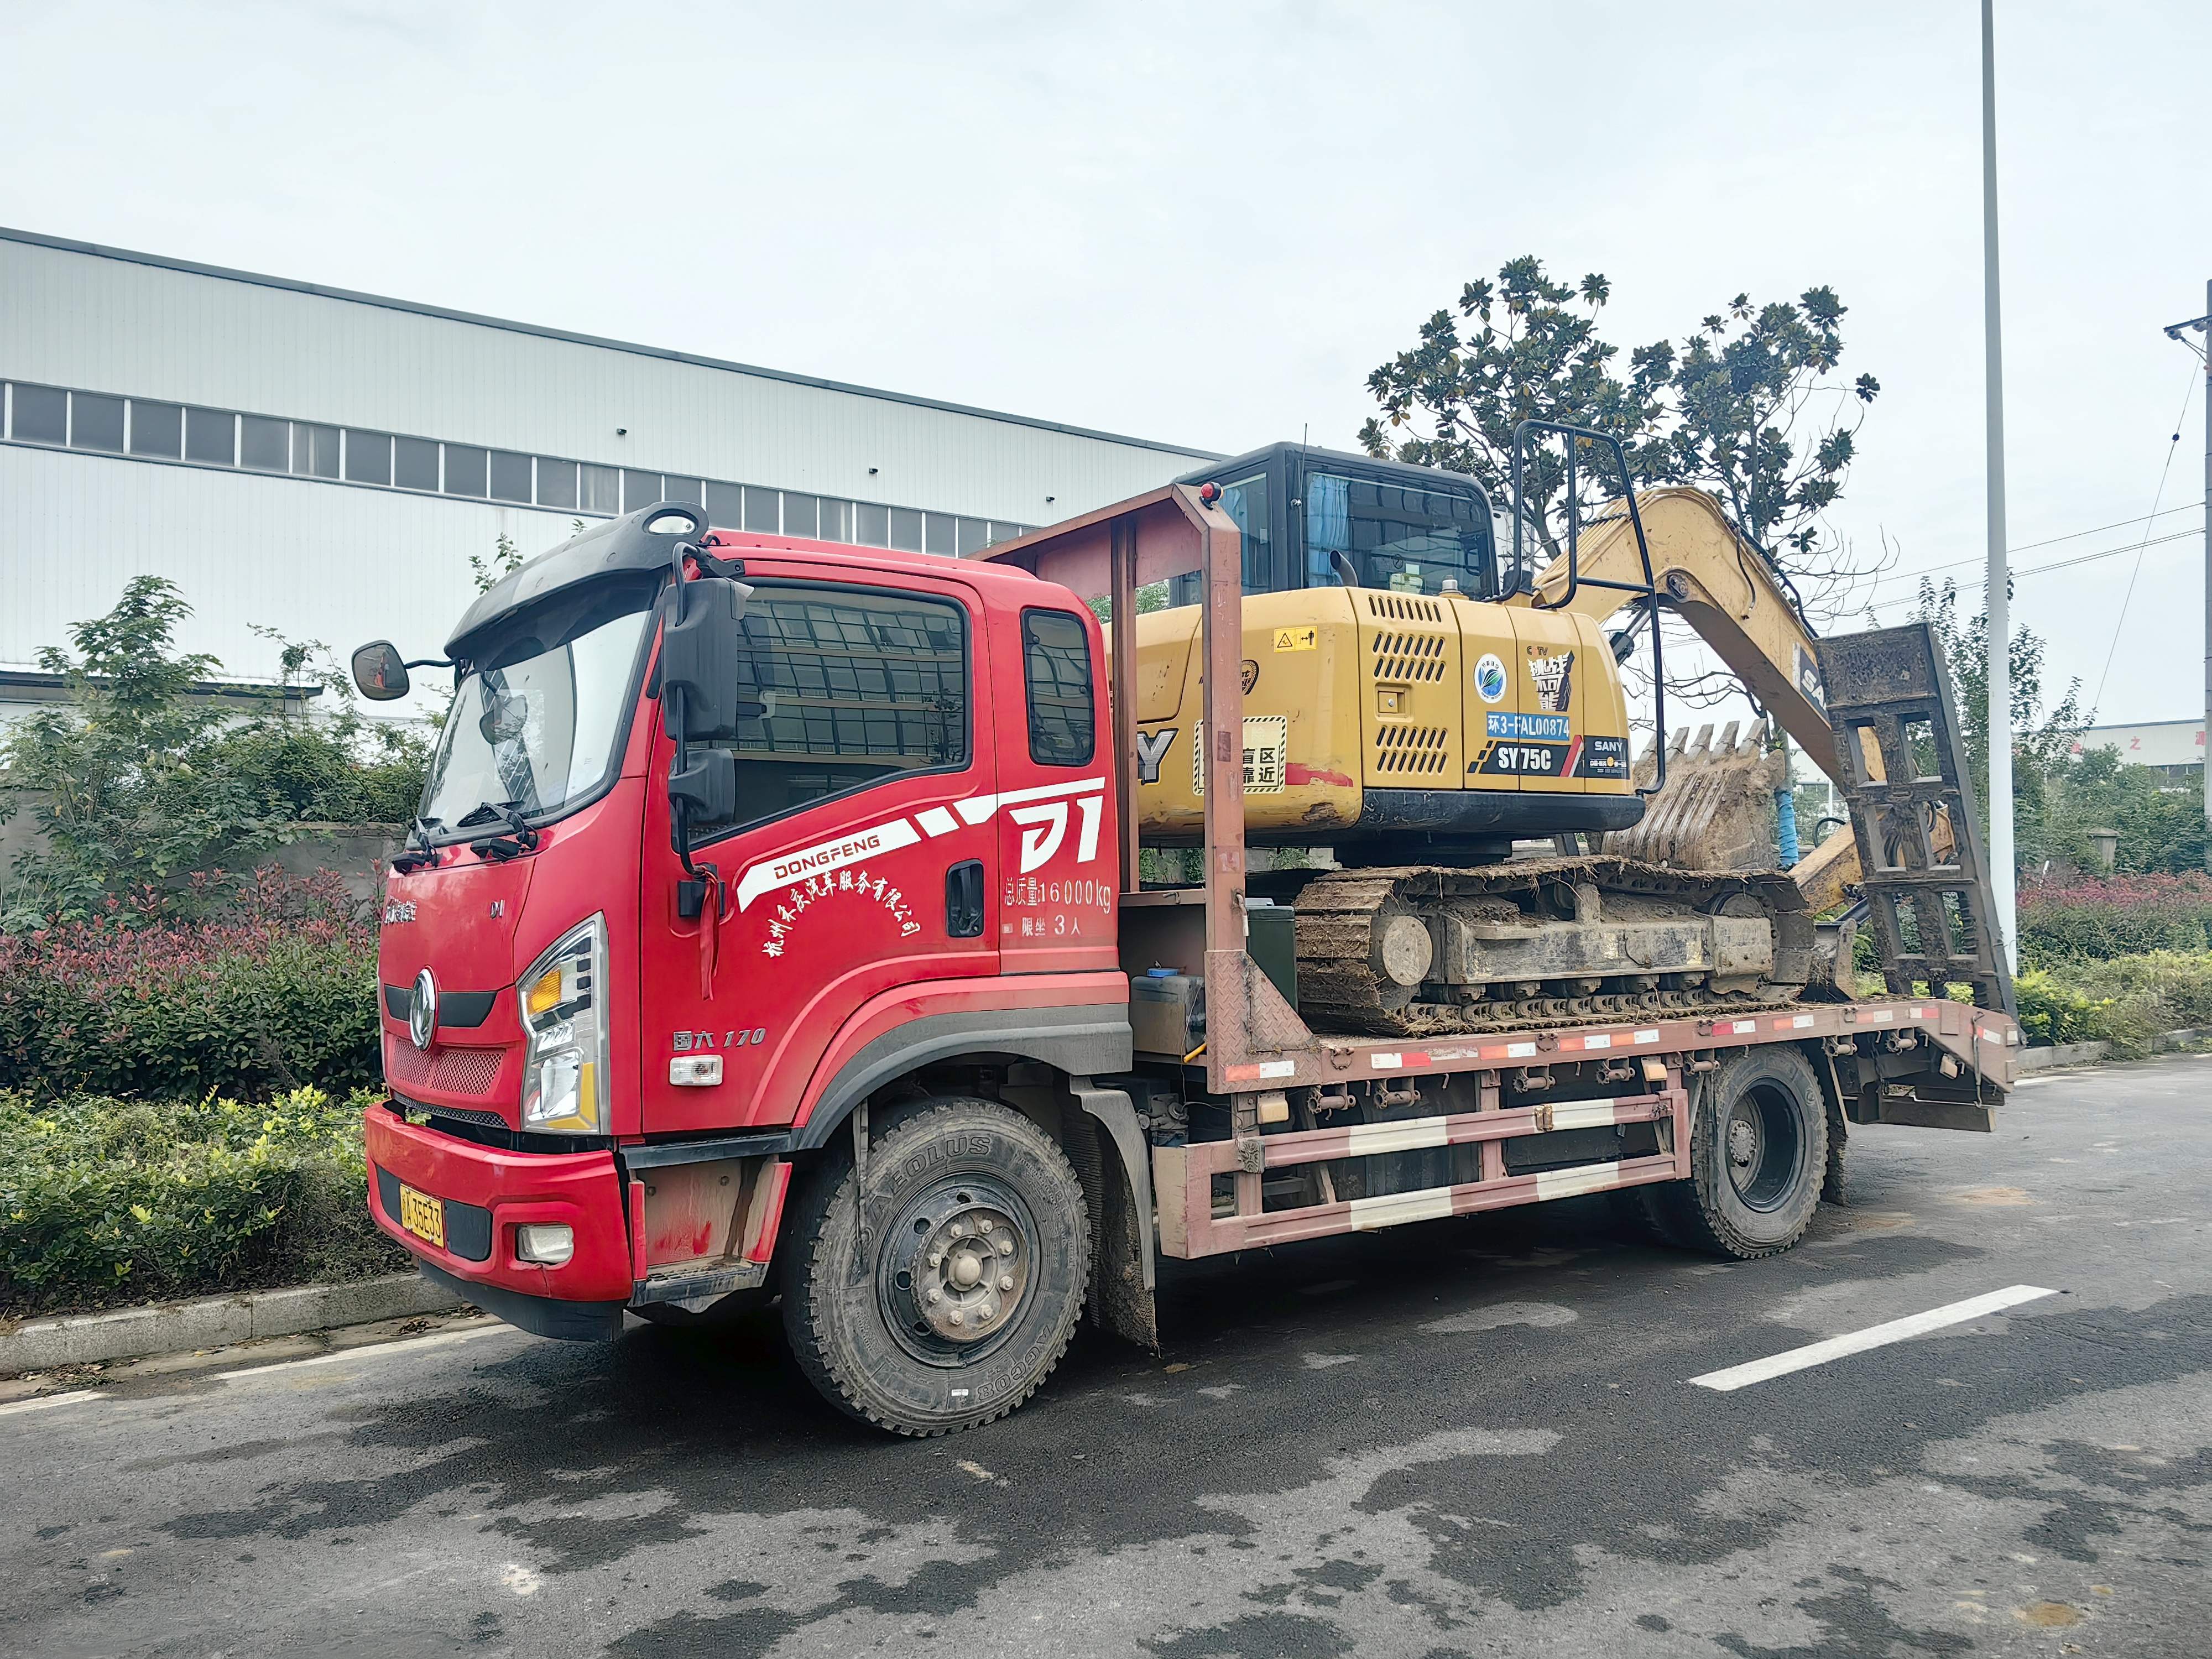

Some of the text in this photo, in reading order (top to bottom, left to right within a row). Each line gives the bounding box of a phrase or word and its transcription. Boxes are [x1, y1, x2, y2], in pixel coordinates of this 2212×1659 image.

[1527, 650, 1570, 676] 挑战
[1538, 691, 1559, 711] 能
[1488, 715, 1569, 737] 环3-FAL00874
[1594, 740, 1623, 752] SANY
[1498, 747, 1551, 770] SY75C
[774, 834, 881, 879] DONGFENG
[723, 1028, 766, 1048] 170
[869, 1136, 991, 1220] AEOLUS
